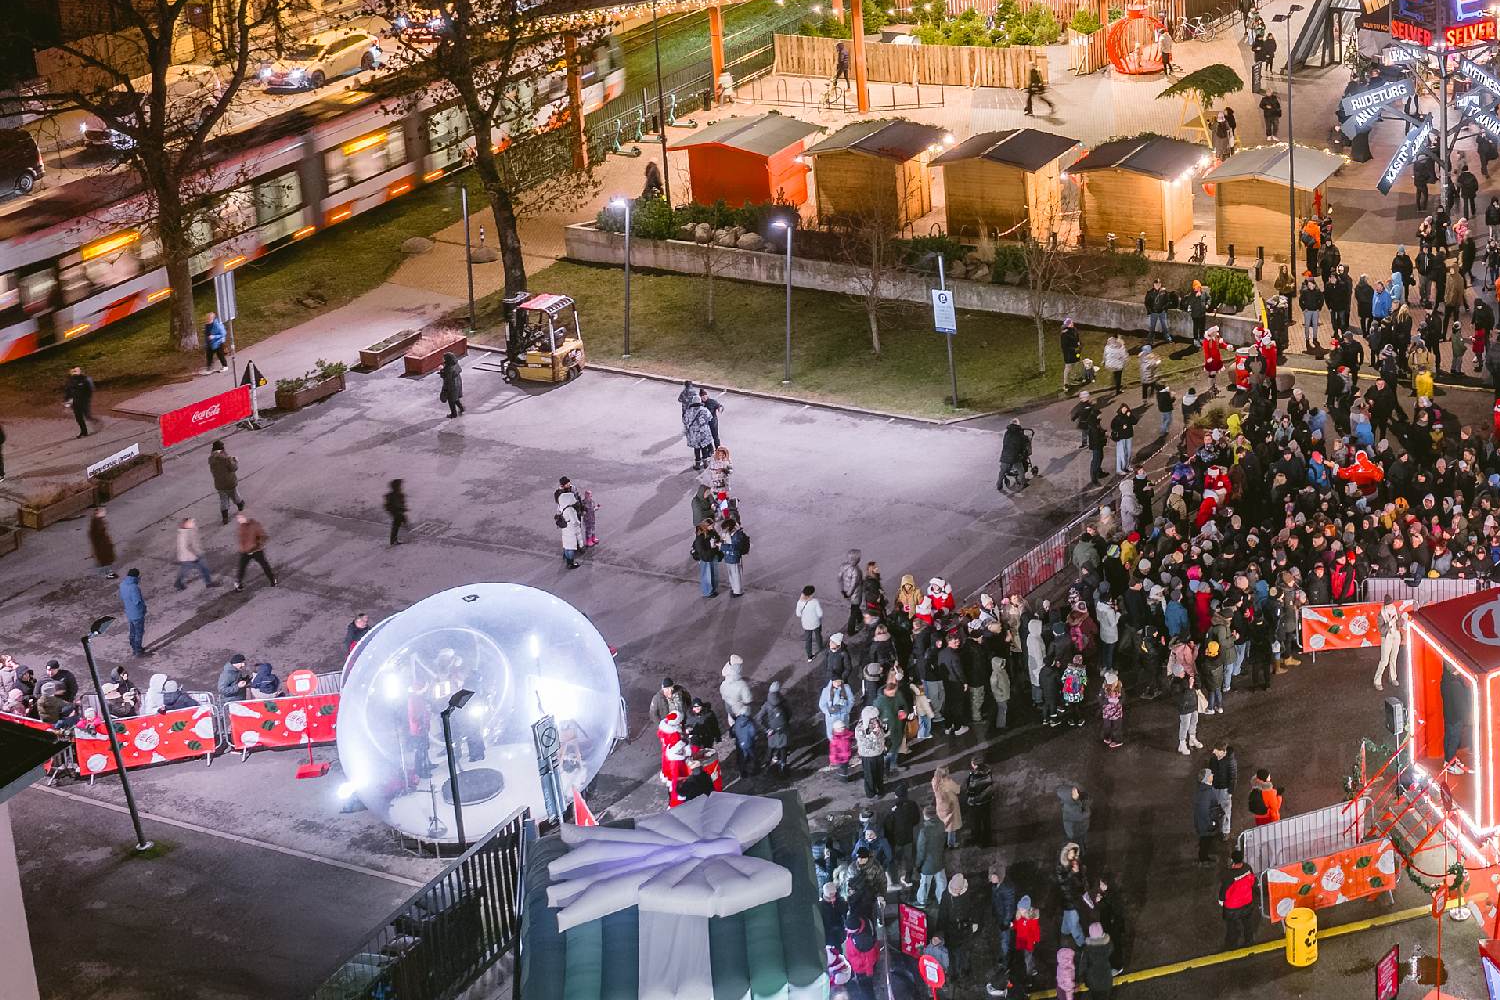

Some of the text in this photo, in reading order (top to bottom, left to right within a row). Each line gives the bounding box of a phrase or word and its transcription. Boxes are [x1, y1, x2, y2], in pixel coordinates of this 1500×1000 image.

[1391, 19, 1432, 47] SELVER
[1446, 21, 1496, 47] SELVER
[1350, 83, 1408, 111] RIIDETURG
